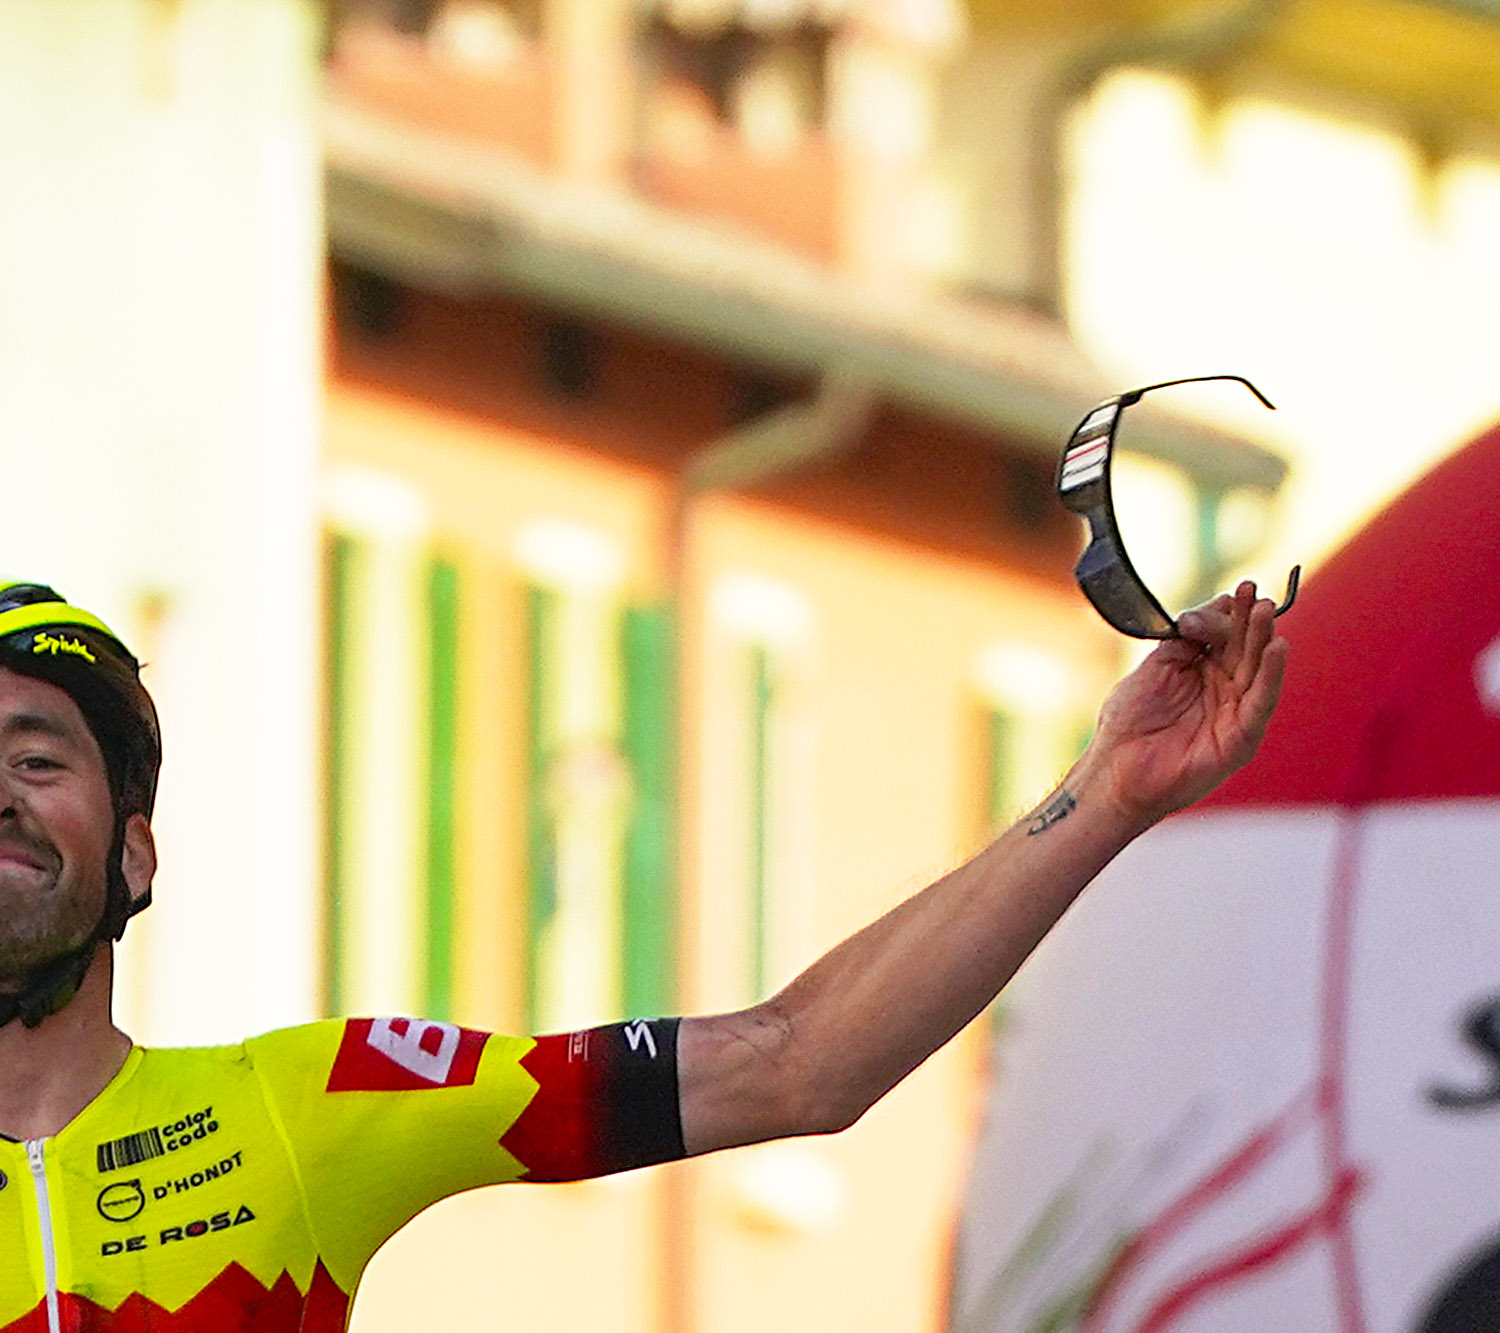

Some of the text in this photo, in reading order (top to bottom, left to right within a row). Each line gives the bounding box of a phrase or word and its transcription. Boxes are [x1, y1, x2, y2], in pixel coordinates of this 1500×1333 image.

[162, 1106, 213, 1137] color
[166, 1120, 219, 1152] code
[153, 1150, 243, 1200] D'HONDT
[101, 1205, 257, 1256] DE ROSA
